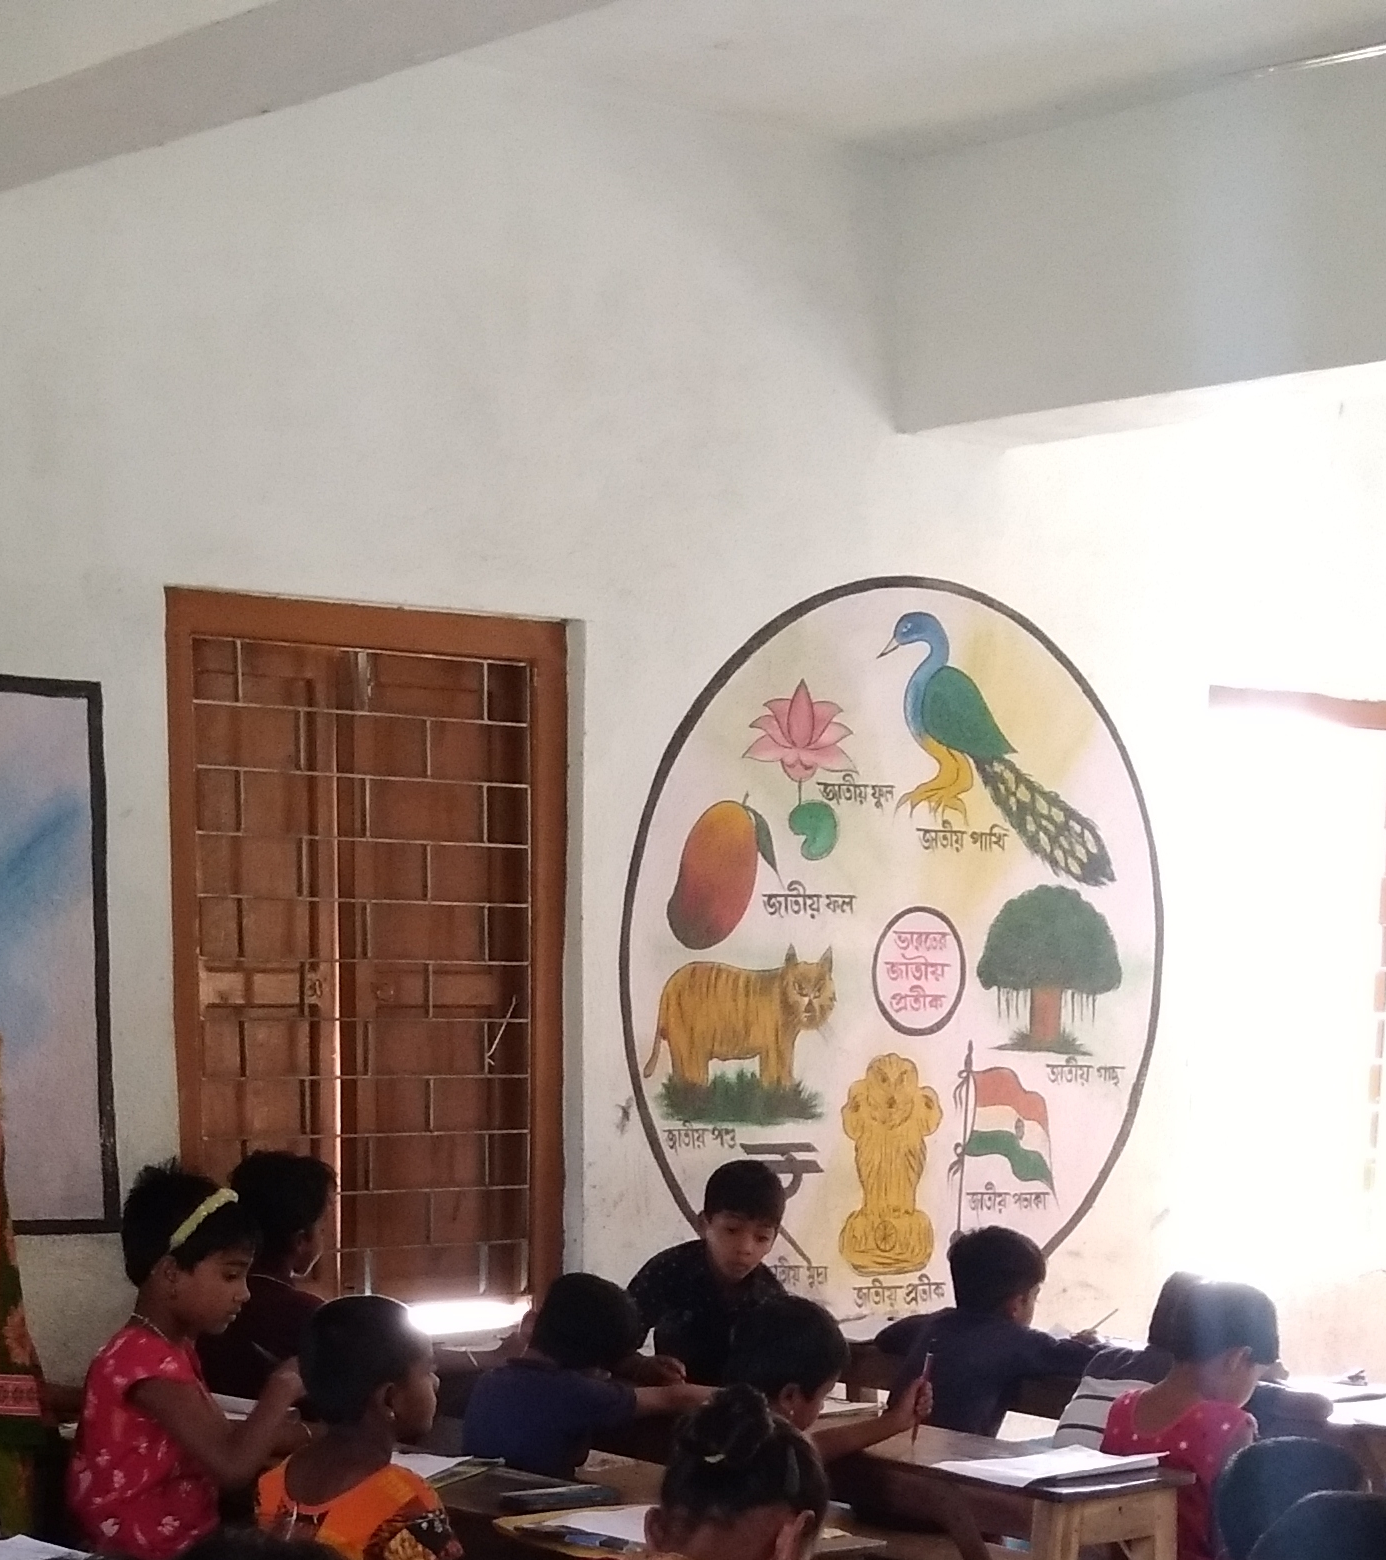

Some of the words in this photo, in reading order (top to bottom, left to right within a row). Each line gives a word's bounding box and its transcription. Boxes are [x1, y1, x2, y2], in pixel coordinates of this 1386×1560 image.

[816, 774, 869, 805] জাতীয়
[970, 823, 1010, 851] পাখি
[762, 880, 822, 918] জাতীয়
[825, 894, 857, 915] ফল
[892, 930, 951, 951] ভারতের
[884, 953, 951, 981] জাতীয়
[889, 984, 947, 1013] প্রতীক
[1046, 1056, 1093, 1086] জাতীয়
[663, 1120, 709, 1155] জাতীয়
[853, 1277, 904, 1308] জাতীয়
